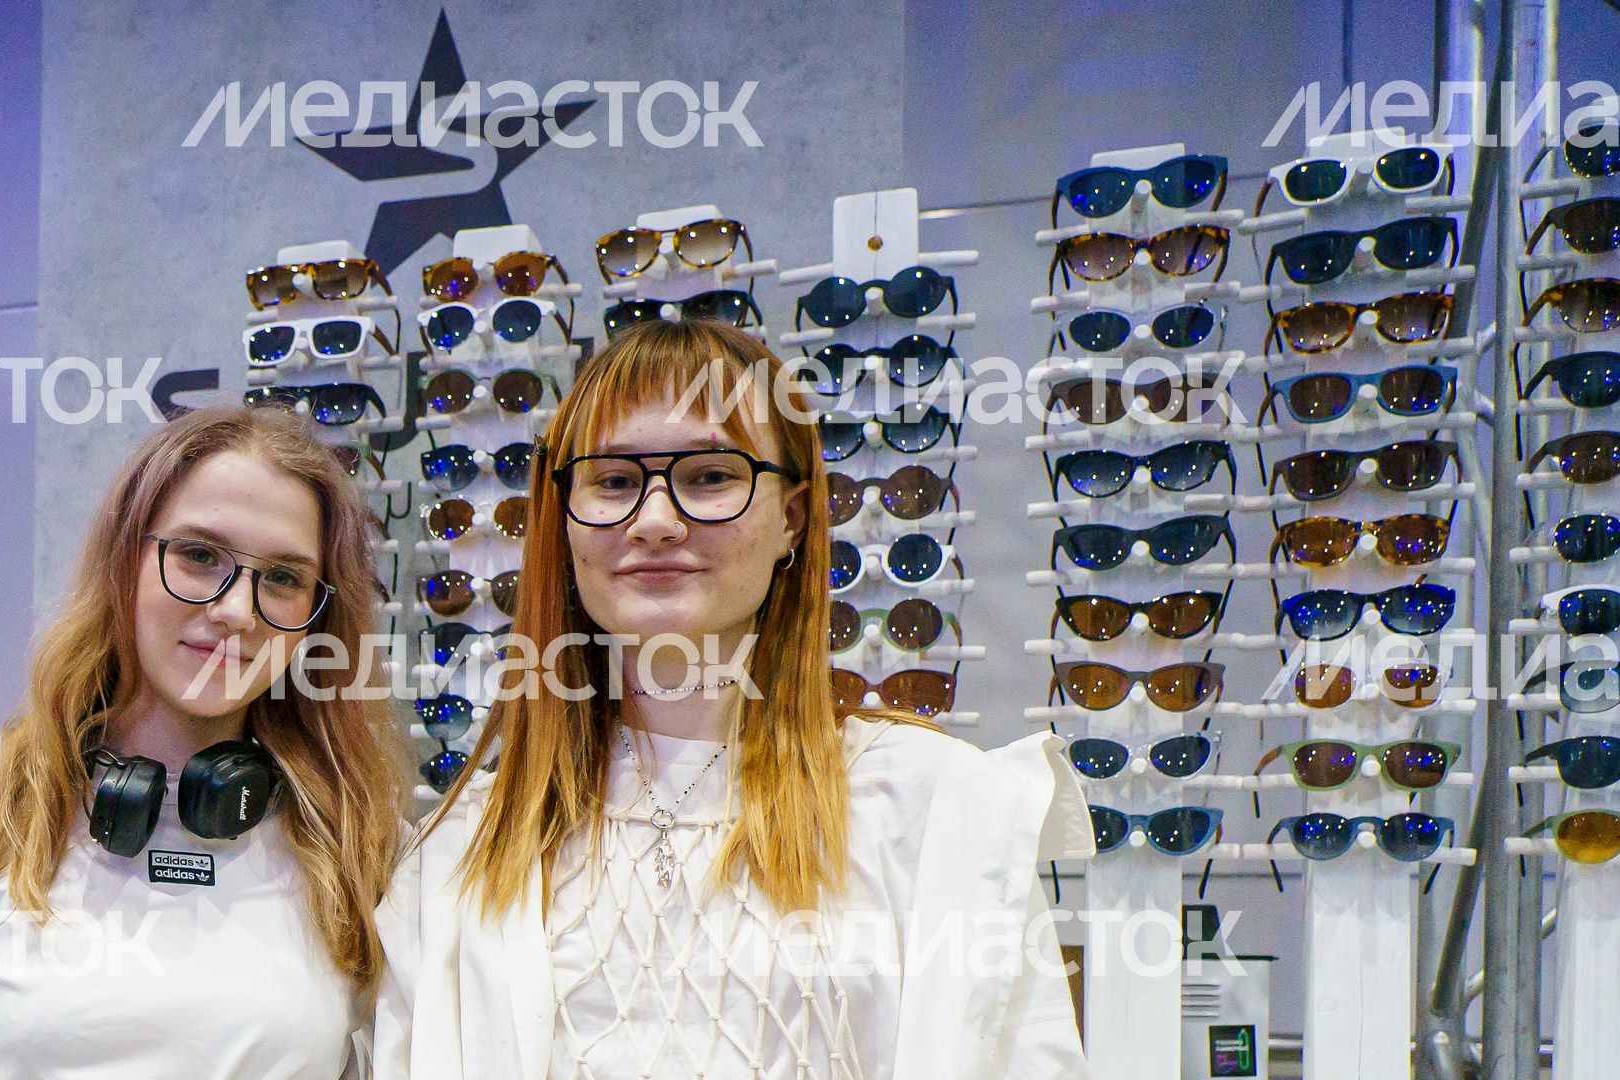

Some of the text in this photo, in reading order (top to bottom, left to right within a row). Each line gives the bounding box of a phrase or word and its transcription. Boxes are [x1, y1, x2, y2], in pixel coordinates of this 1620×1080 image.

[240, 786, 251, 821] Marshall
[154, 856, 194, 867] adidas
[155, 868, 195, 880] adidas
